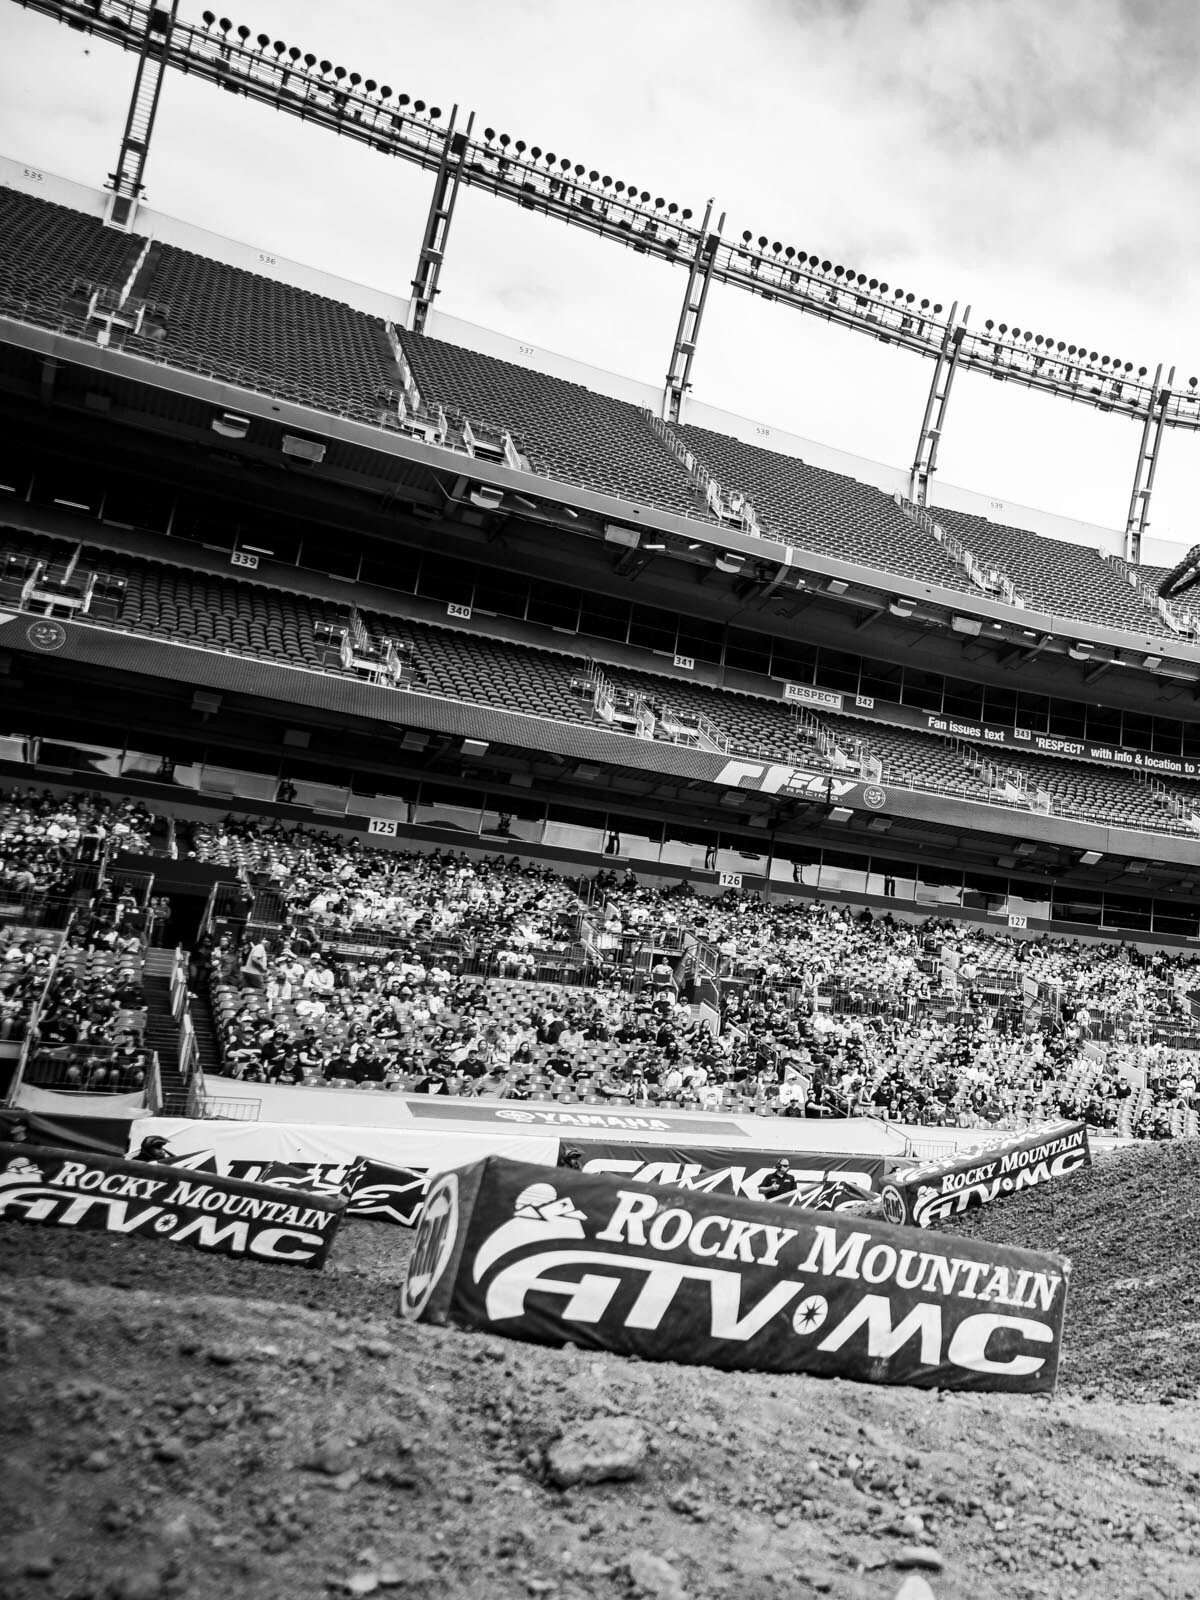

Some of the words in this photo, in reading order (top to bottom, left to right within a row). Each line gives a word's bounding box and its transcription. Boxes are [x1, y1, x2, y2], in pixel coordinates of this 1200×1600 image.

[24, 169, 43, 182] 535
[259, 254, 276, 266] 536
[519, 346, 534, 355] 537
[756, 428, 770, 436] 538
[234, 553, 257, 567] 339
[449, 602, 470, 617] 340
[676, 655, 693, 668] 341
[788, 686, 841, 704] RESPECT
[856, 696, 873, 707] 342
[1015, 729, 1030, 739] 343
[928, 716, 947, 730] Fan
[949, 720, 981, 737] issues
[984, 728, 1005, 741] text
[1035, 737, 1085, 755] 'RESPECT'
[1091, 747, 1113, 760] with
[1114, 750, 1133, 763] info
[1134, 753, 1143, 765] &
[1144, 755, 1182, 772] location
[1184, 763, 1195, 773] to
[373, 821, 395, 835] 125
[722, 874, 740, 886] 126
[1011, 916, 1026, 926] 127
[536, 1112, 671, 1131] YAMAHA
[942, 1162, 996, 1194] ROCKY
[1000, 1131, 1084, 1173] MOUNTAIN
[50, 1161, 167, 1200] ROCKY
[163, 1181, 337, 1231] MOUNTAIN
[597, 1190, 799, 1268] ROCKY
[798, 1226, 1062, 1312] MOUNTAIN
